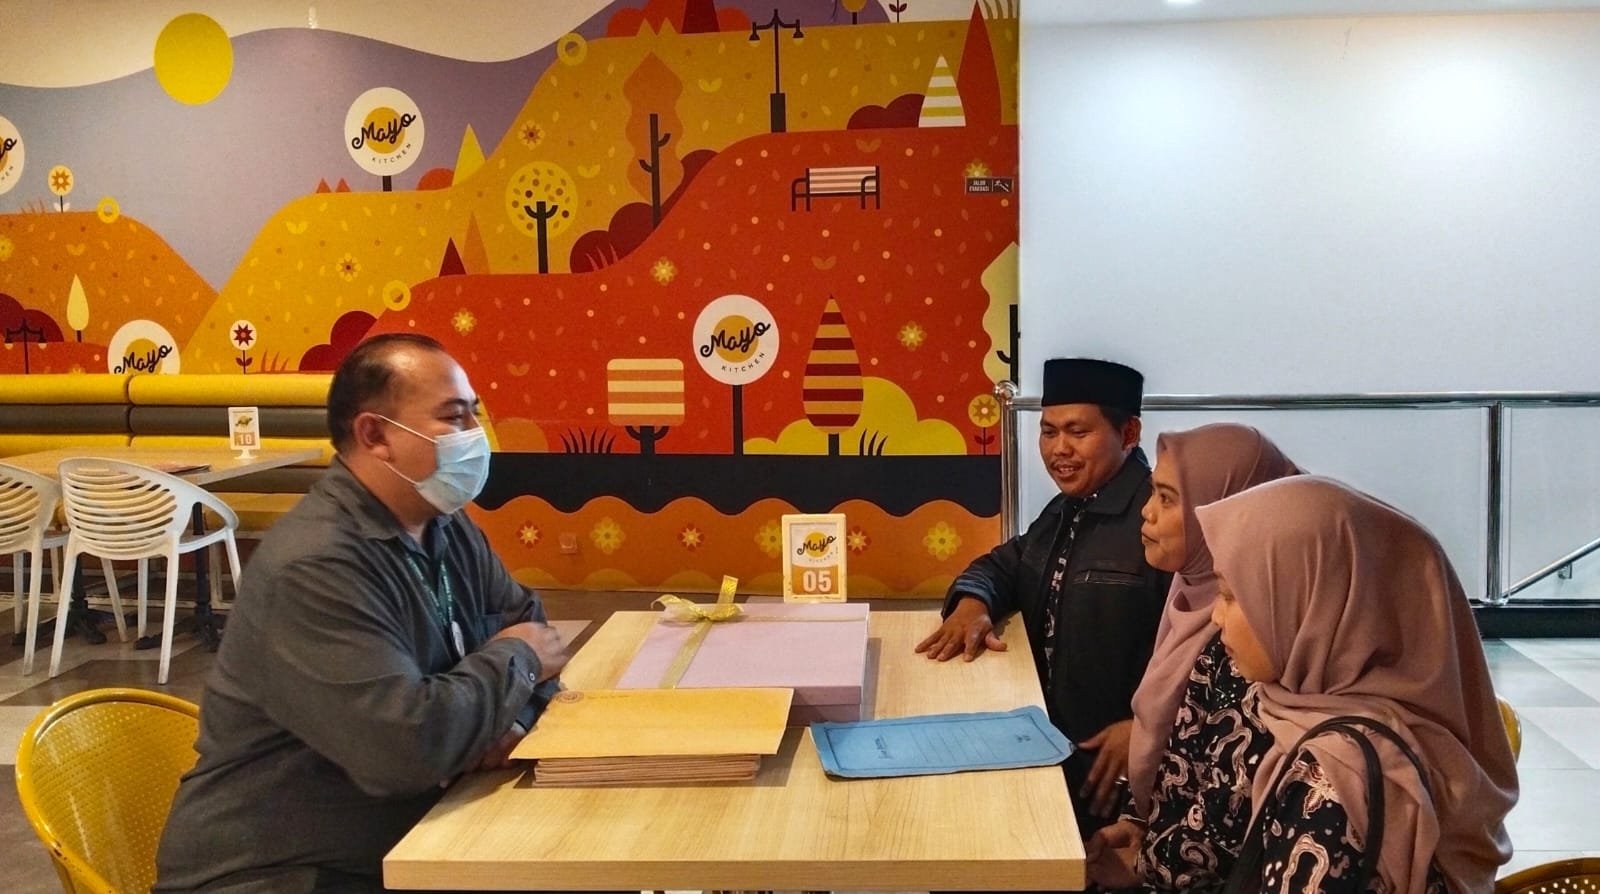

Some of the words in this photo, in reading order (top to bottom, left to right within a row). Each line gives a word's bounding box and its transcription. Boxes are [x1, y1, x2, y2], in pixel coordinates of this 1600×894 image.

[351, 113, 416, 149] Mayo
[700, 322, 771, 357] Mayo
[114, 345, 173, 374] Mayo
[721, 352, 765, 373] KITCHEN
[797, 535, 837, 555] Mayo
[803, 570, 832, 592] 05
